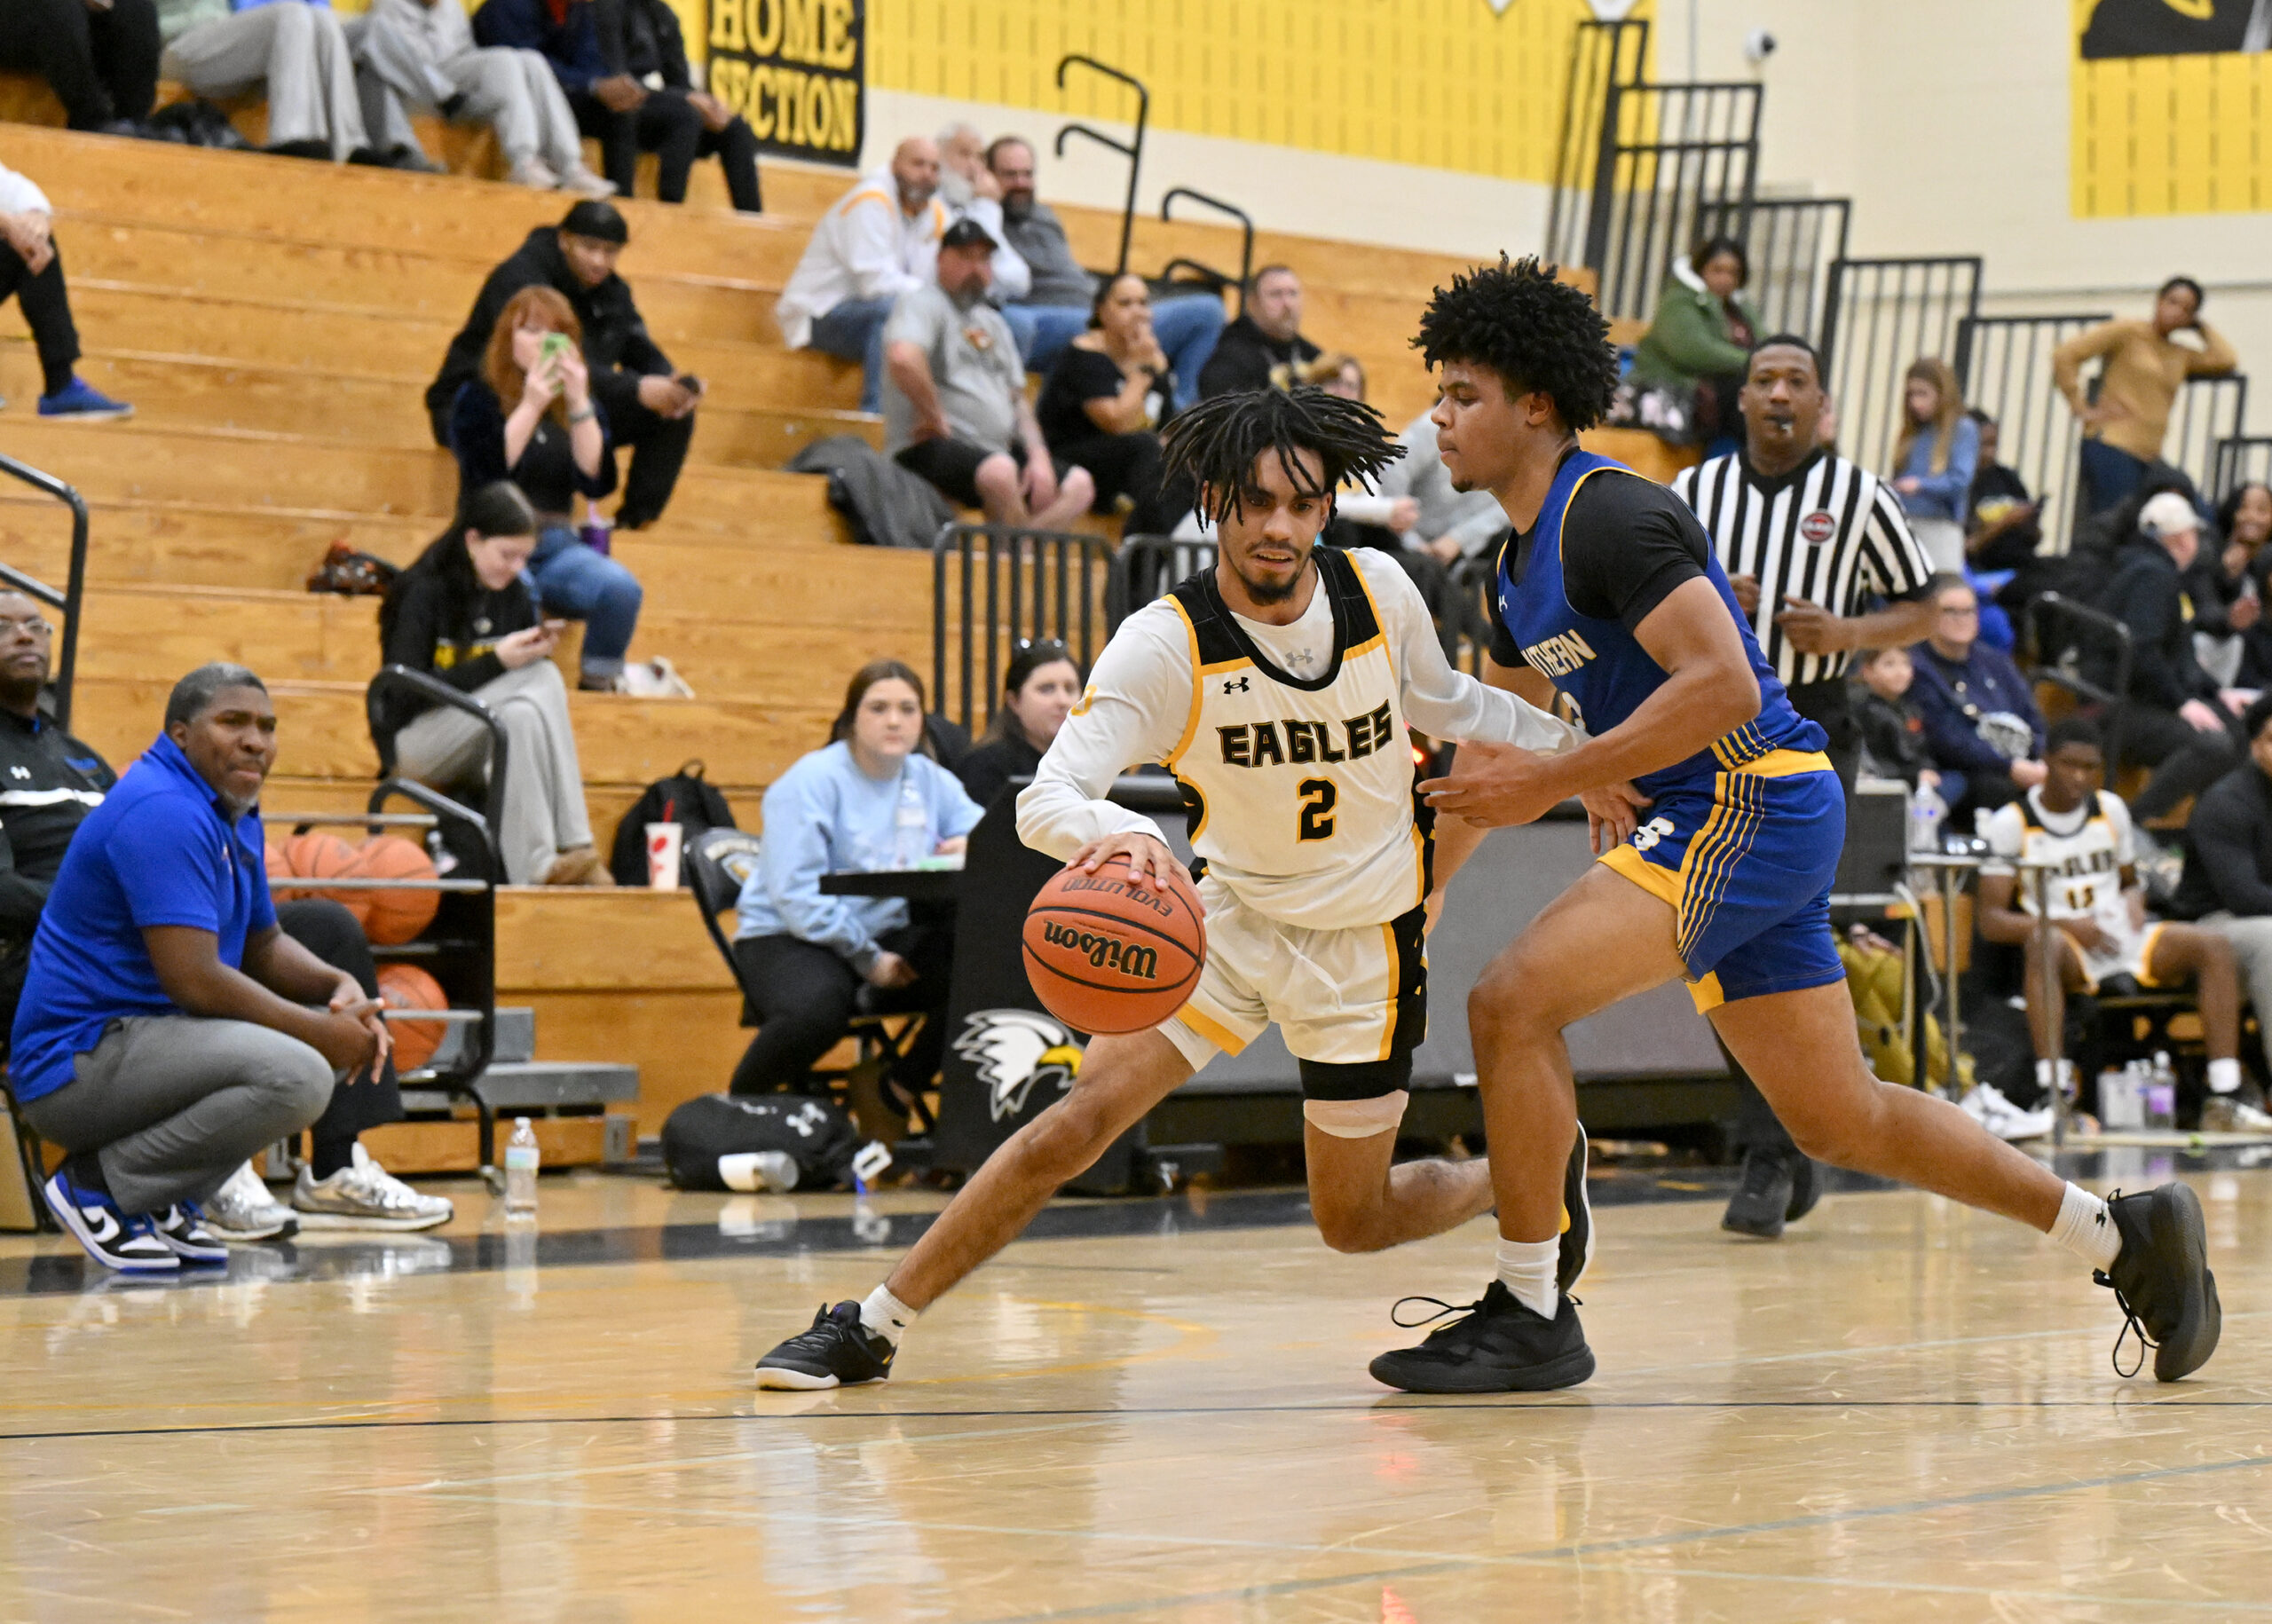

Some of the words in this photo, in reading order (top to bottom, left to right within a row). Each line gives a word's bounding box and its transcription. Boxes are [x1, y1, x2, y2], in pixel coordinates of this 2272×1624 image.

[710, 0, 856, 71] HOME
[1215, 698, 1393, 769] EAGLES
[1296, 775, 1339, 844] 2
[1044, 919, 1157, 981] Wilson
